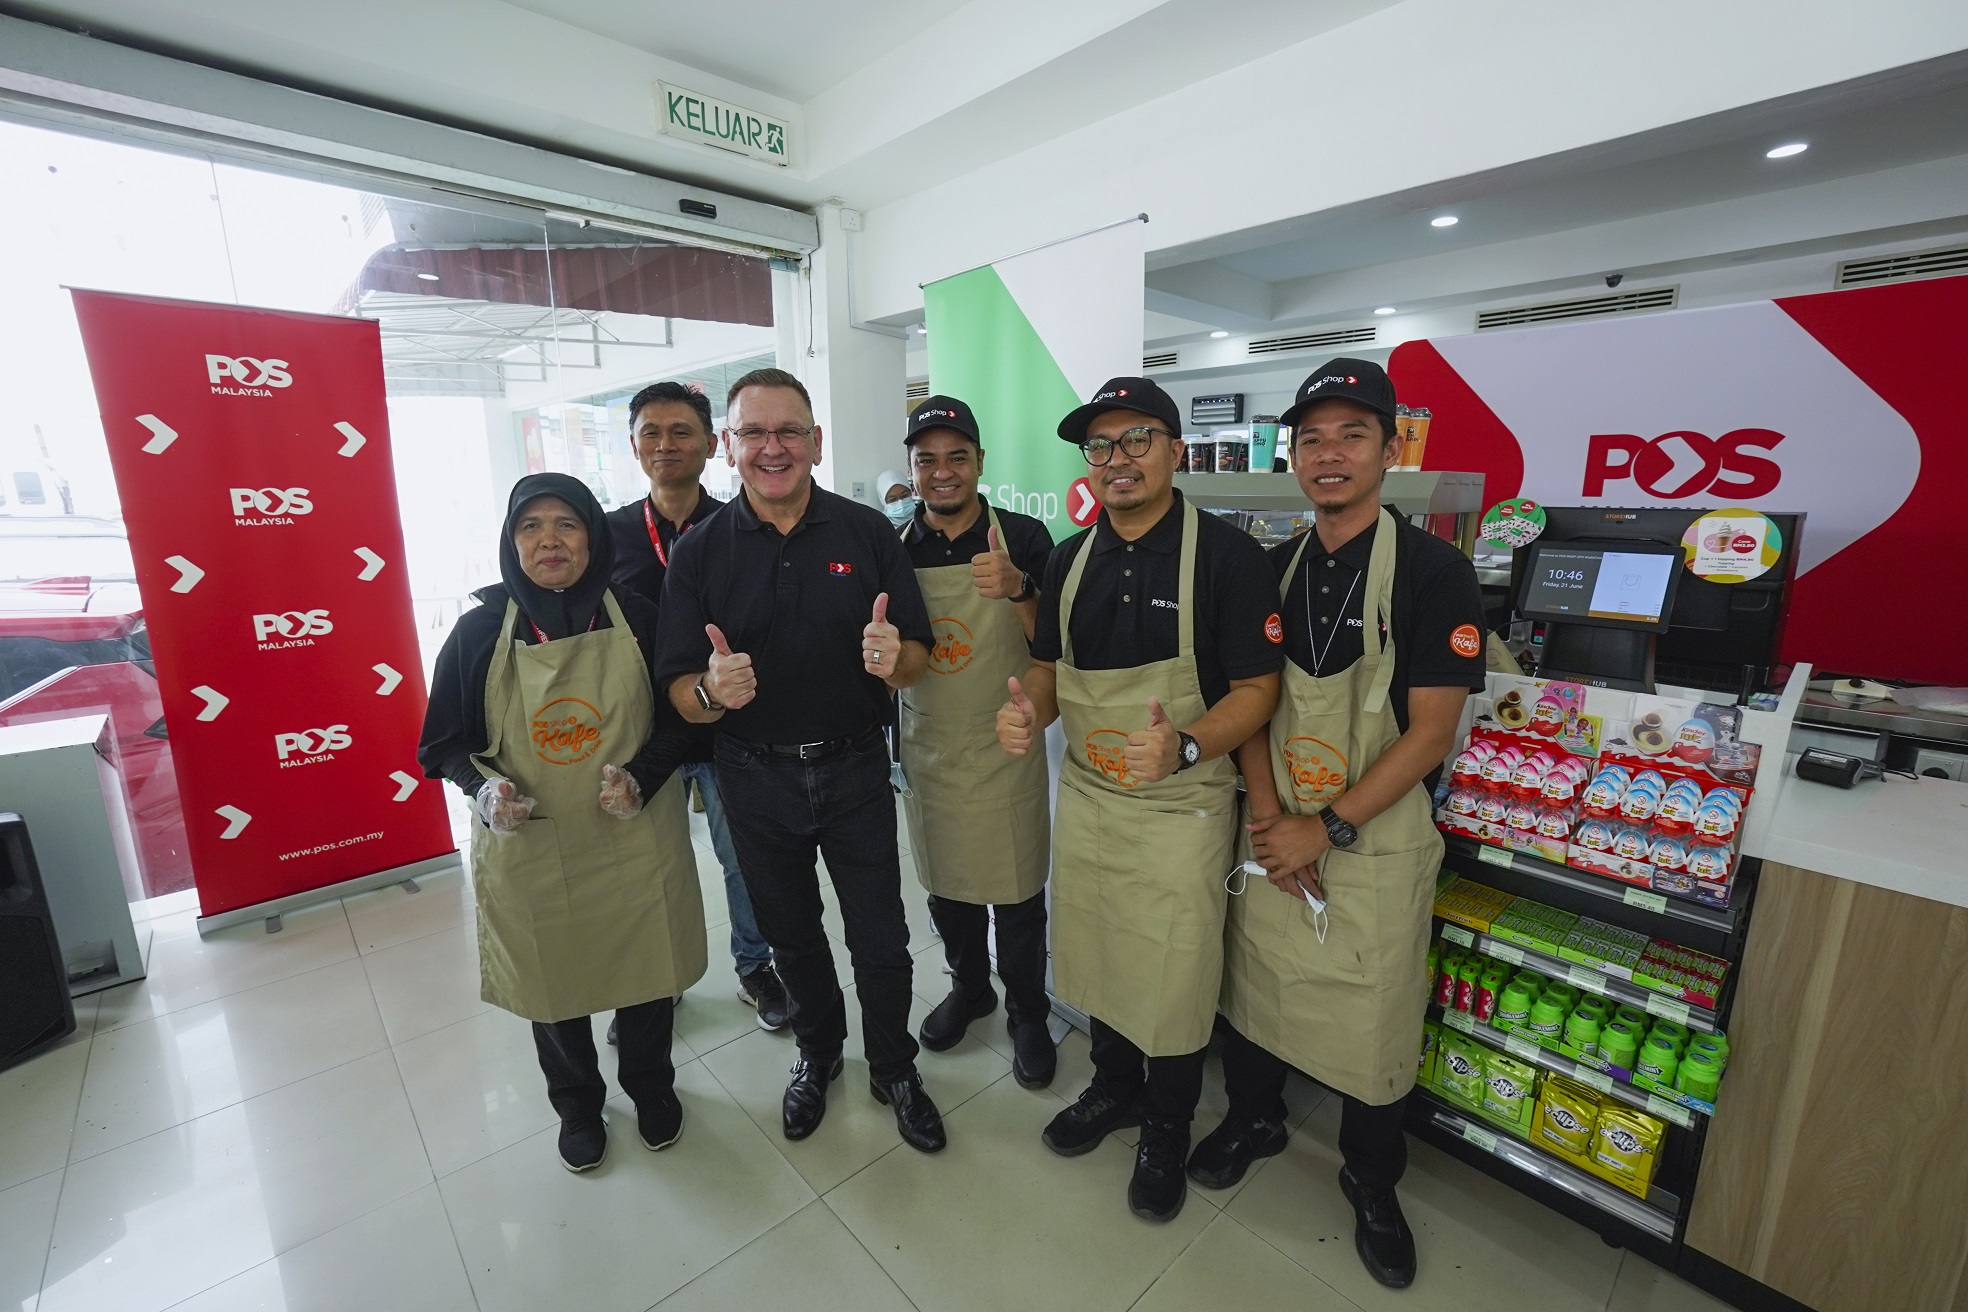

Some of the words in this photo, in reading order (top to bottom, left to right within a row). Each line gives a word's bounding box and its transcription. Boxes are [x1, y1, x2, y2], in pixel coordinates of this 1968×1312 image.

[668, 91, 762, 150] KELUAR
[205, 354, 293, 388] POS
[211, 386, 273, 398] MALAYSIA
[1307, 380, 1322, 395] POS
[1321, 375, 1344, 384] Shop
[1582, 428, 1786, 499] POS
[229, 487, 314, 516] POS
[998, 484, 1058, 524] Shop
[235, 517, 294, 527] MALAYSIA
[829, 562, 852, 573] POS
[1548, 569, 1583, 581] 10:46
[1542, 581, 1560, 589] Friday,
[1151, 599, 1166, 607] POS
[253, 609, 334, 641] POS
[1346, 618, 1363, 627] POS
[258, 639, 315, 651] MALAYSIA
[1454, 637, 1478, 650] Kafe
[274, 724, 352, 760] POS
[532, 723, 601, 752] Kafe
[279, 753, 335, 769] MALAYSIA
[1088, 751, 1130, 780] Kaf
[1285, 759, 1346, 792] Kafe
[279, 830, 384, 861] www.pos.com.my
[1484, 1077, 1528, 1098] eclipse
[1544, 1105, 1590, 1134] eclipse
